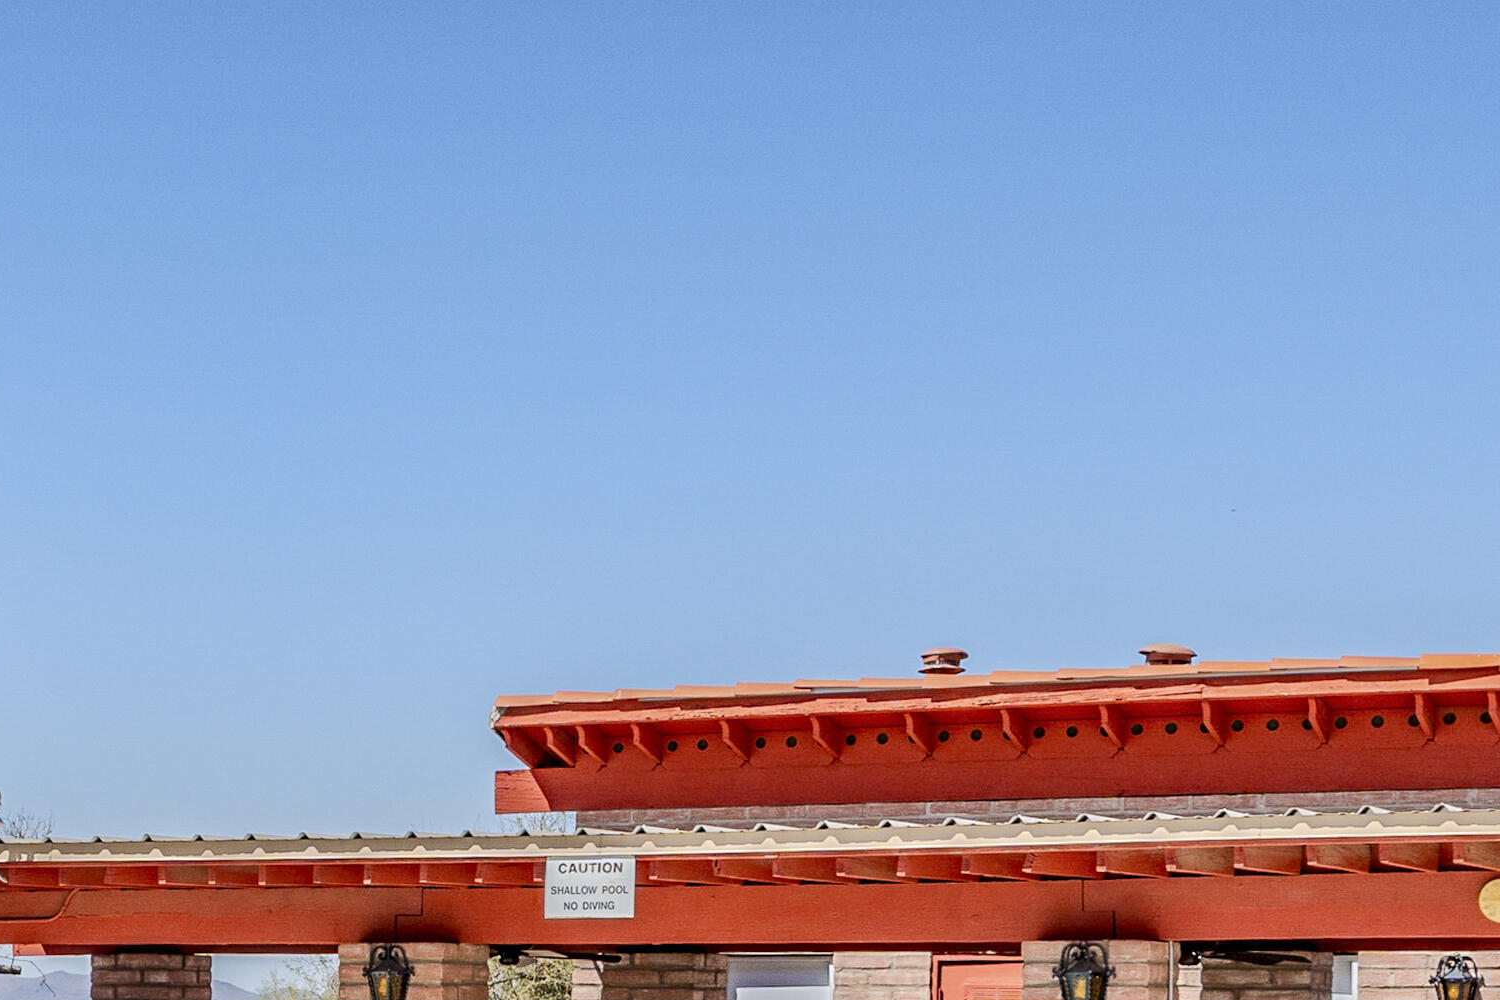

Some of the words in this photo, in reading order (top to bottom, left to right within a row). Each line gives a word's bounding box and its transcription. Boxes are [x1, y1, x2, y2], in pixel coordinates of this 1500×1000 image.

[558, 862, 623, 874] CAUTION
[550, 885, 598, 895] SHALLOW
[602, 885, 629, 895] POOL
[563, 901, 578, 911] NO
[582, 900, 615, 911] DIVING
